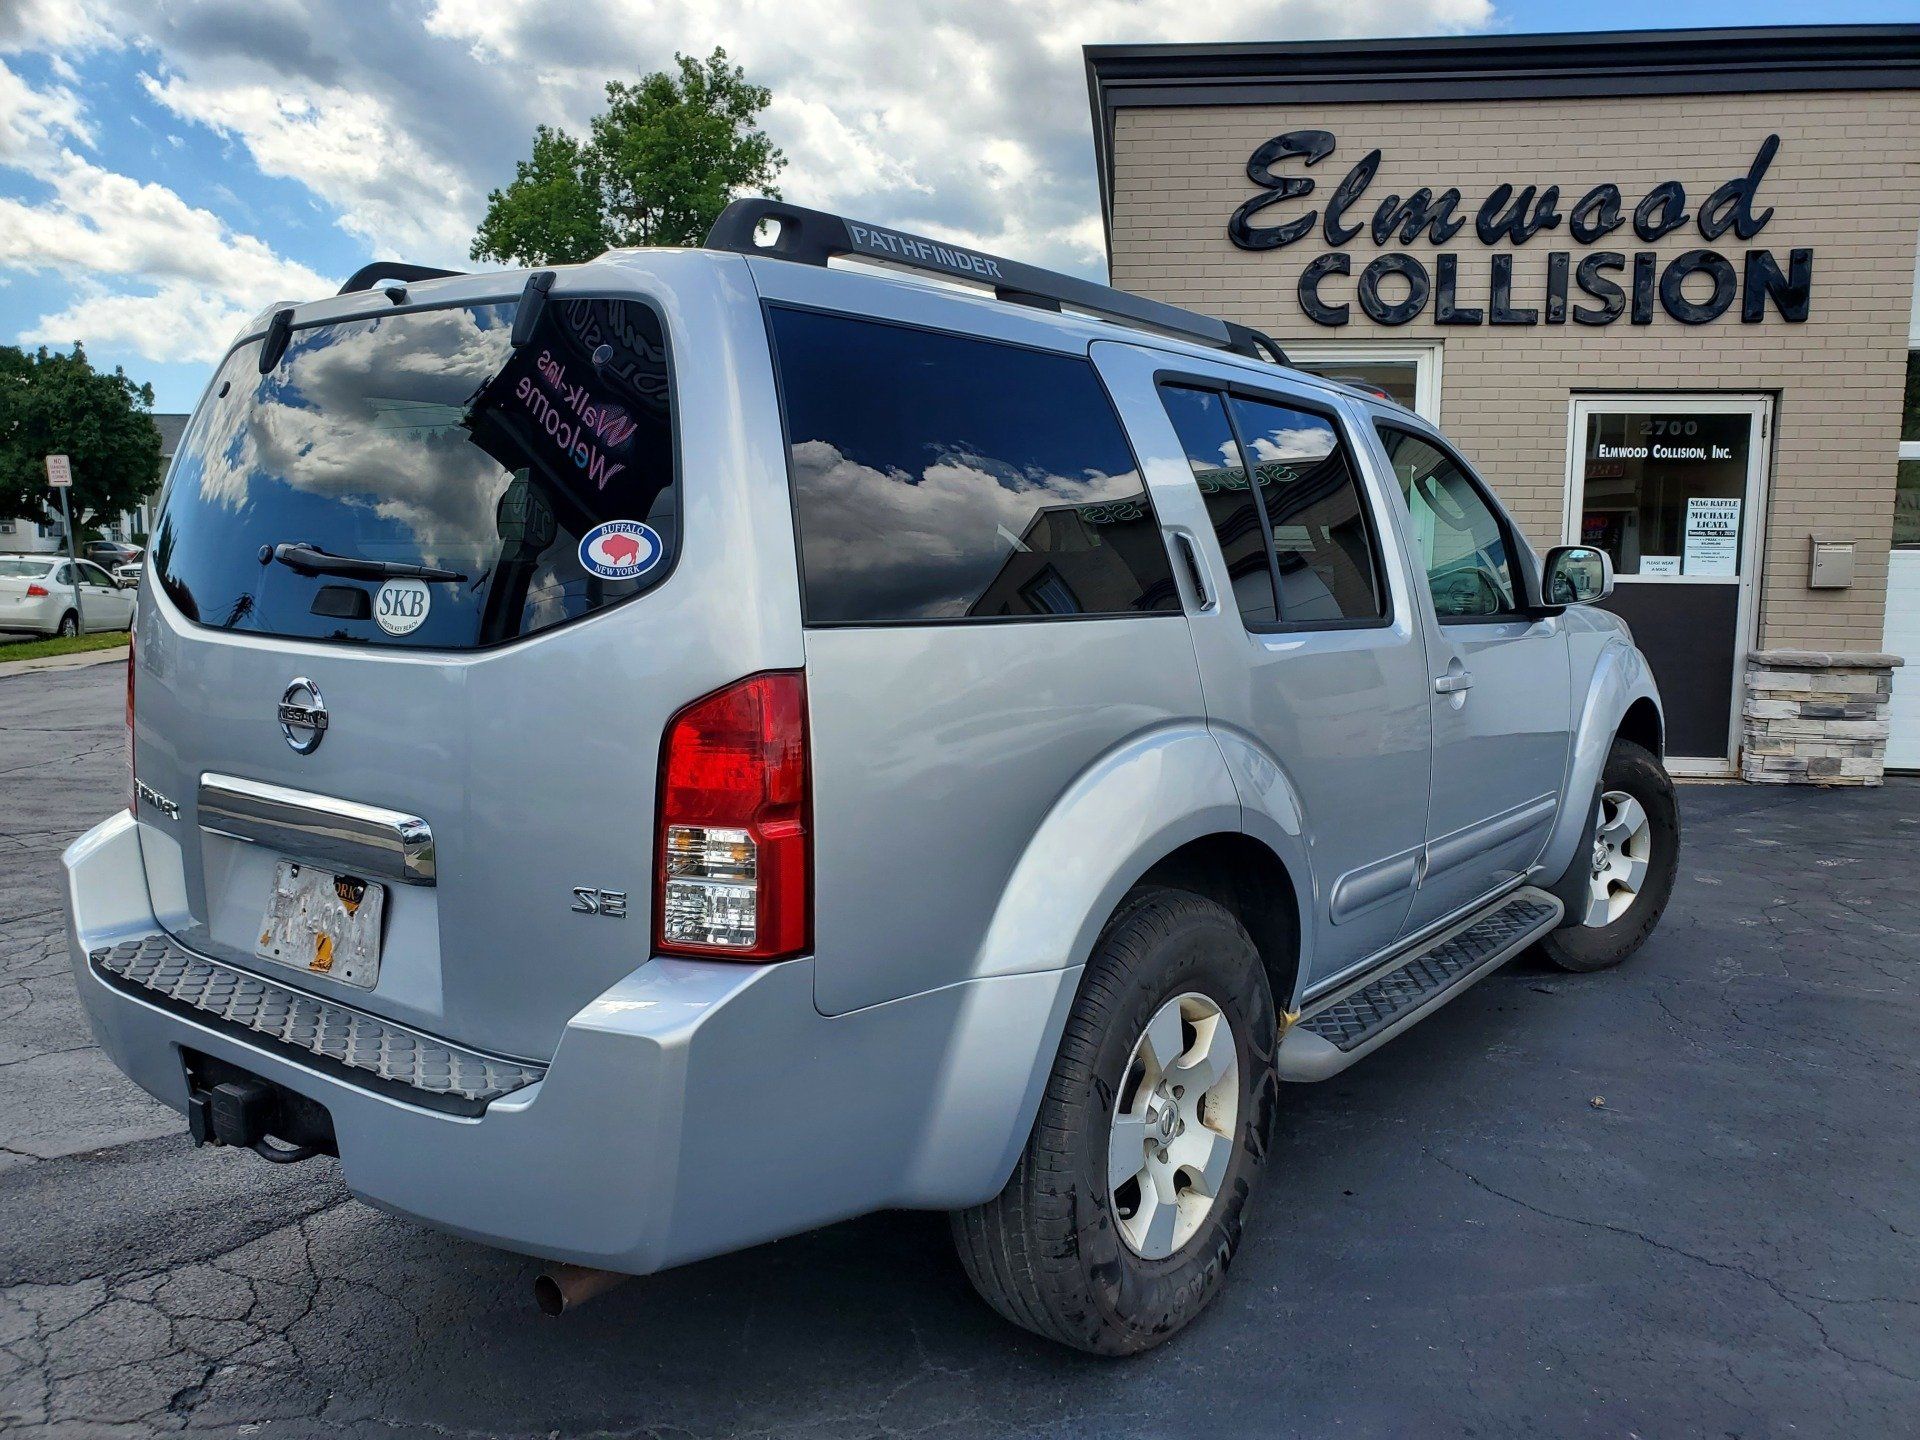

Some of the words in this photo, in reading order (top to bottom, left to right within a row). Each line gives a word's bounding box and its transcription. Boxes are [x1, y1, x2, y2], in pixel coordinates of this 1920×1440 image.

[1228, 129, 1781, 251] Elmwood
[850, 224, 1004, 280] PATHFINDER
[1297, 248, 1814, 327] COLLISION
[1639, 420, 1698, 436] 2700
[1710, 500, 1738, 508] RAFFLE
[1690, 512, 1736, 520] MICHAEL
[601, 523, 645, 536] BUFFALO
[1697, 521, 1728, 529] LICATA
[594, 564, 615, 576] NEW
[616, 564, 641, 576] YORK
[380, 588, 425, 618] SKB
[403, 619, 420, 632] BEACH
[279, 706, 319, 725] NISSAN
[570, 885, 628, 919] SE
